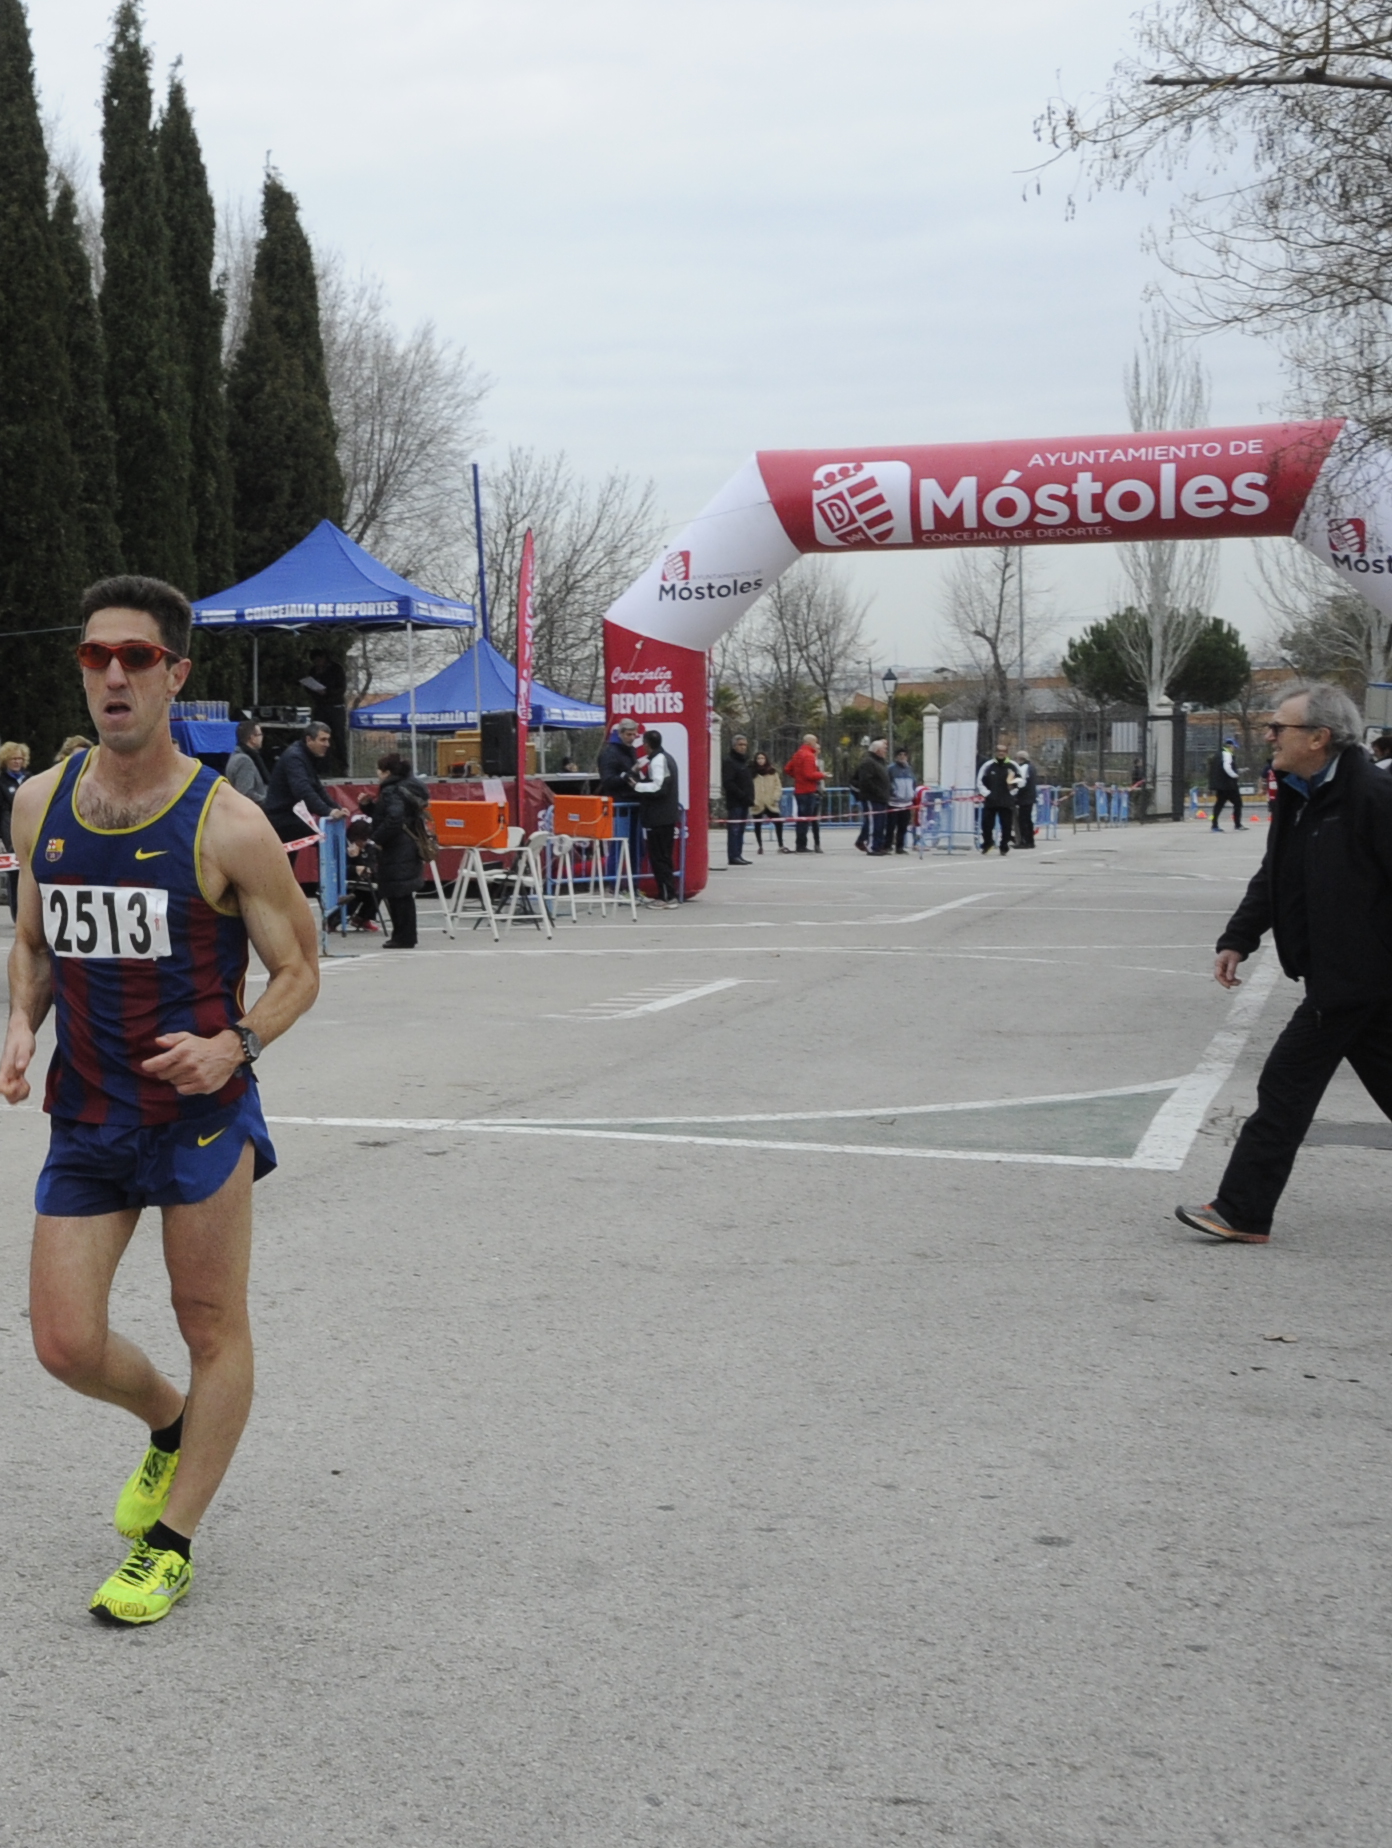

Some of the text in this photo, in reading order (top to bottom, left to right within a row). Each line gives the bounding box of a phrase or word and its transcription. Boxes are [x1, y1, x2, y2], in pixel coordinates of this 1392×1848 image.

[1027, 439, 1264, 468] AYUNTAMIENTO DE
[919, 462, 1270, 531] Móstoles
[922, 526, 1113, 543] CONCEJALÍA DE DEPORTES
[659, 578, 763, 602] Móstoles
[318, 603, 334, 617] DE
[335, 601, 399, 617] DEPORTES
[654, 680, 672, 692] de
[611, 691, 684, 715] DEPORTES
[49, 889, 152, 955] 2513
